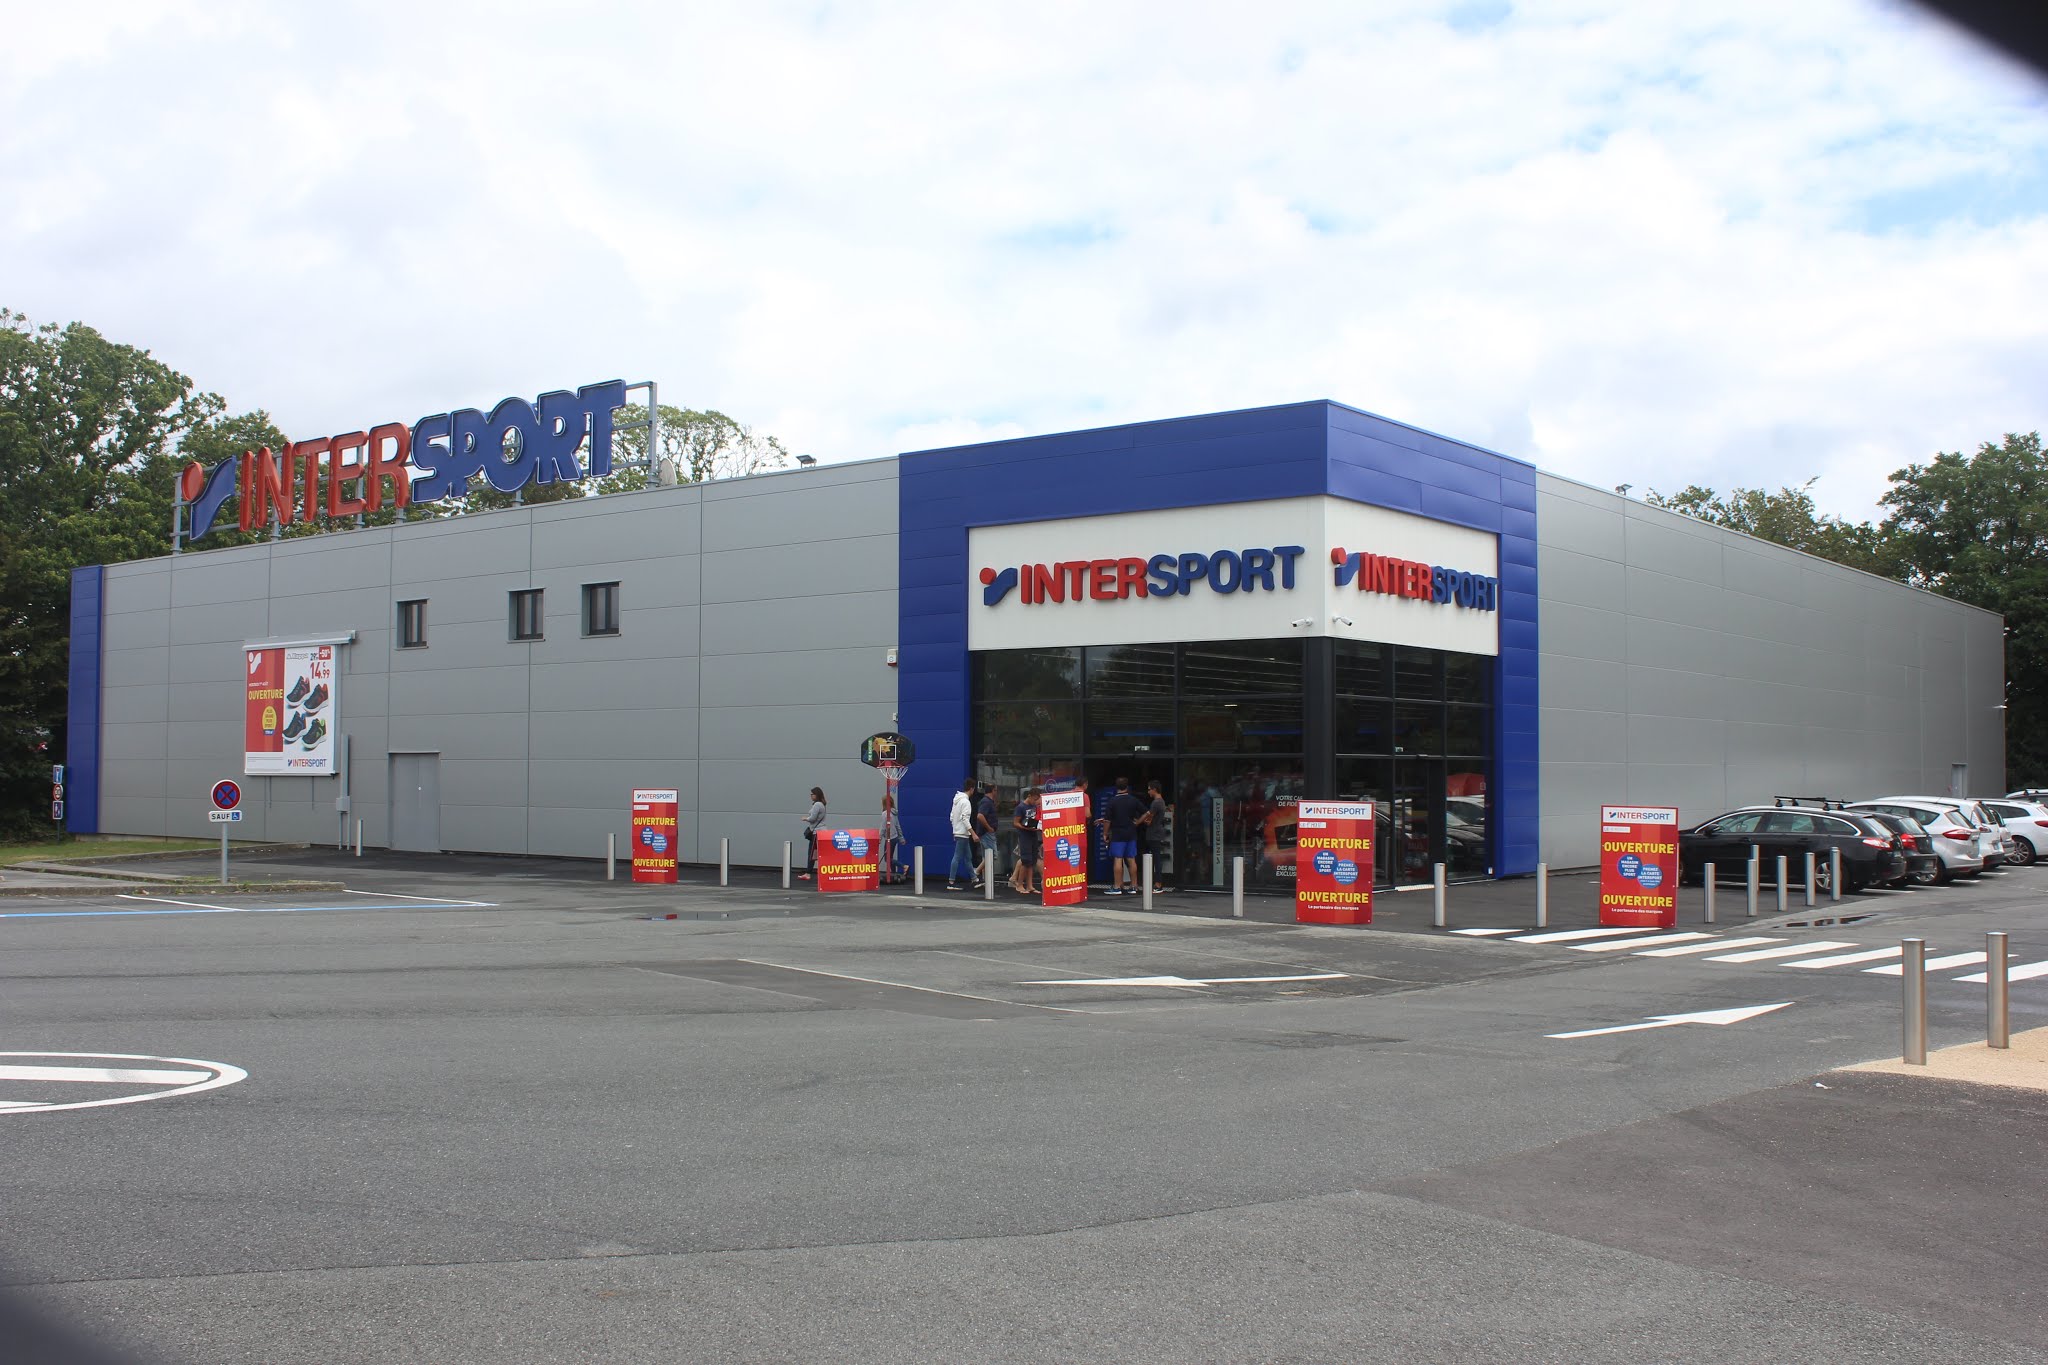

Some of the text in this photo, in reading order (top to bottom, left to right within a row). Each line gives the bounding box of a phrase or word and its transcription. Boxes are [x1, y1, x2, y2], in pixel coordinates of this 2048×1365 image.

[239, 379, 626, 532] INTERSPORT
[1021, 545, 1305, 605] INTERSPORT
[1358, 552, 1498, 612] INTERSPORT
[248, 689, 284, 700] OUVERTURE
[292, 759, 327, 768] INTERSPORT
[1050, 796, 1081, 806] INTERSPORT
[1313, 807, 1366, 816] INTERSPORT
[1617, 811, 1671, 820] INTERSPORT
[633, 817, 675, 826] OUVERTURE
[1044, 824, 1085, 838] OUVERTURE
[1299, 837, 1370, 850] OUVERTURE
[1603, 841, 1675, 854] OUVERTURE
[633, 858, 675, 868] OUVERTURE
[820, 864, 877, 874] OUVERTURE
[1045, 873, 1086, 887] OUVERTURE
[1299, 891, 1369, 904] OUVERTURE
[1602, 894, 1673, 907] OUVERTURE
